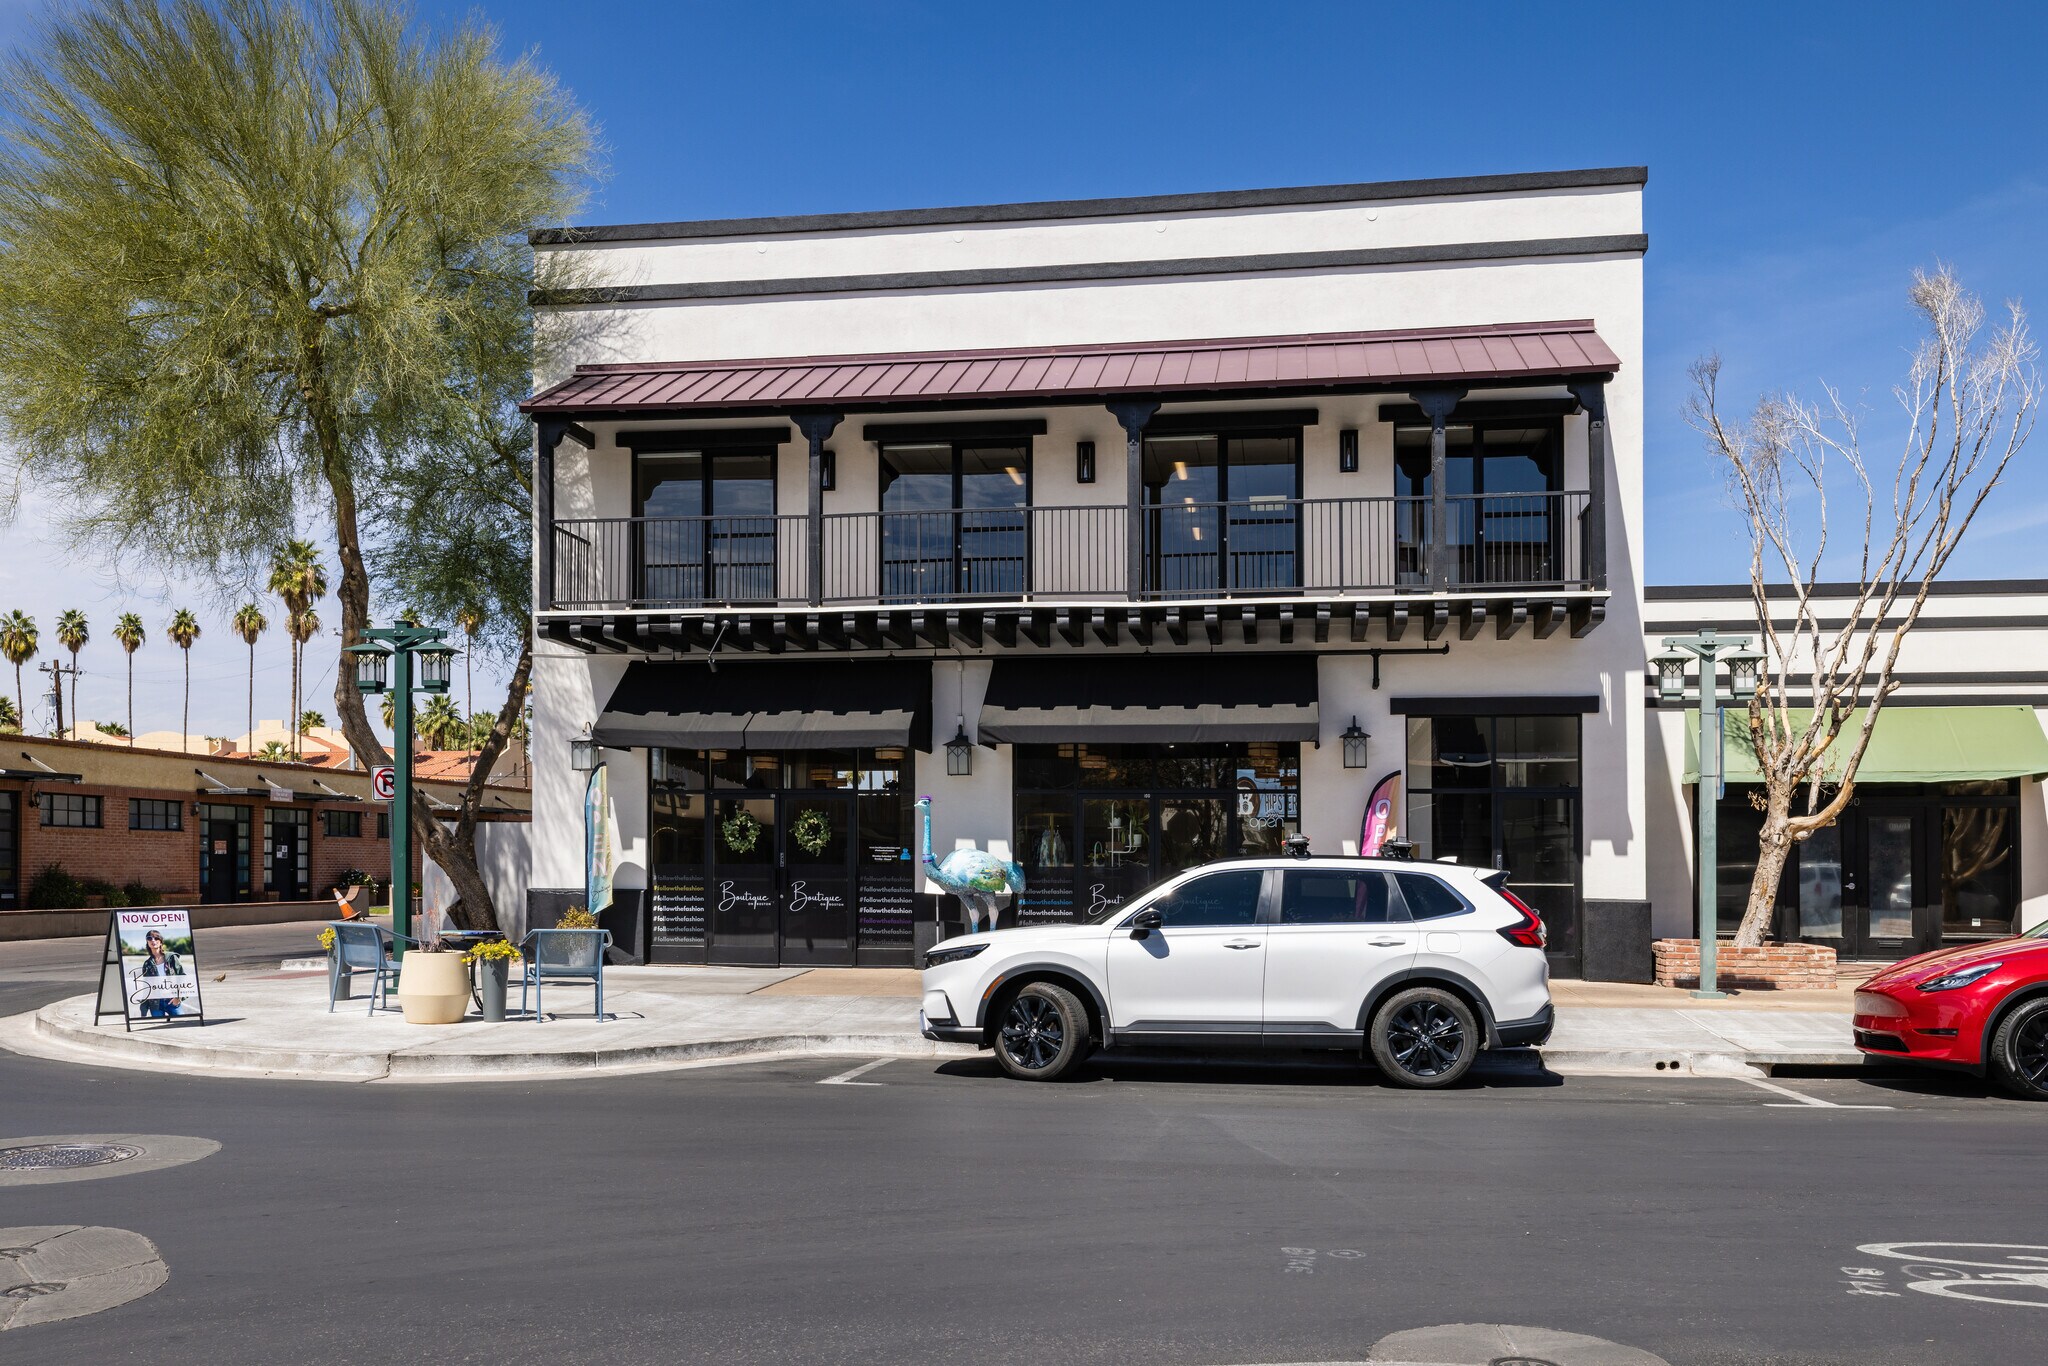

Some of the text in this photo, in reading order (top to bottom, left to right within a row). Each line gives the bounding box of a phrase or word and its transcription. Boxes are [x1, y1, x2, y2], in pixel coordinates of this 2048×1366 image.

[1265, 794, 1298, 812] HIPSER
[590, 787, 608, 877] OPEN
[1249, 816, 1284, 831] open
[1372, 798, 1392, 857] OP
[718, 880, 769, 912] Boutique
[789, 880, 842, 912] Boutique
[1088, 883, 1125, 916] Bout
[122, 913, 185, 923] NOW OPEN!
[859, 917, 913, 925] #followthefashion
[128, 967, 195, 1005] Boutique
